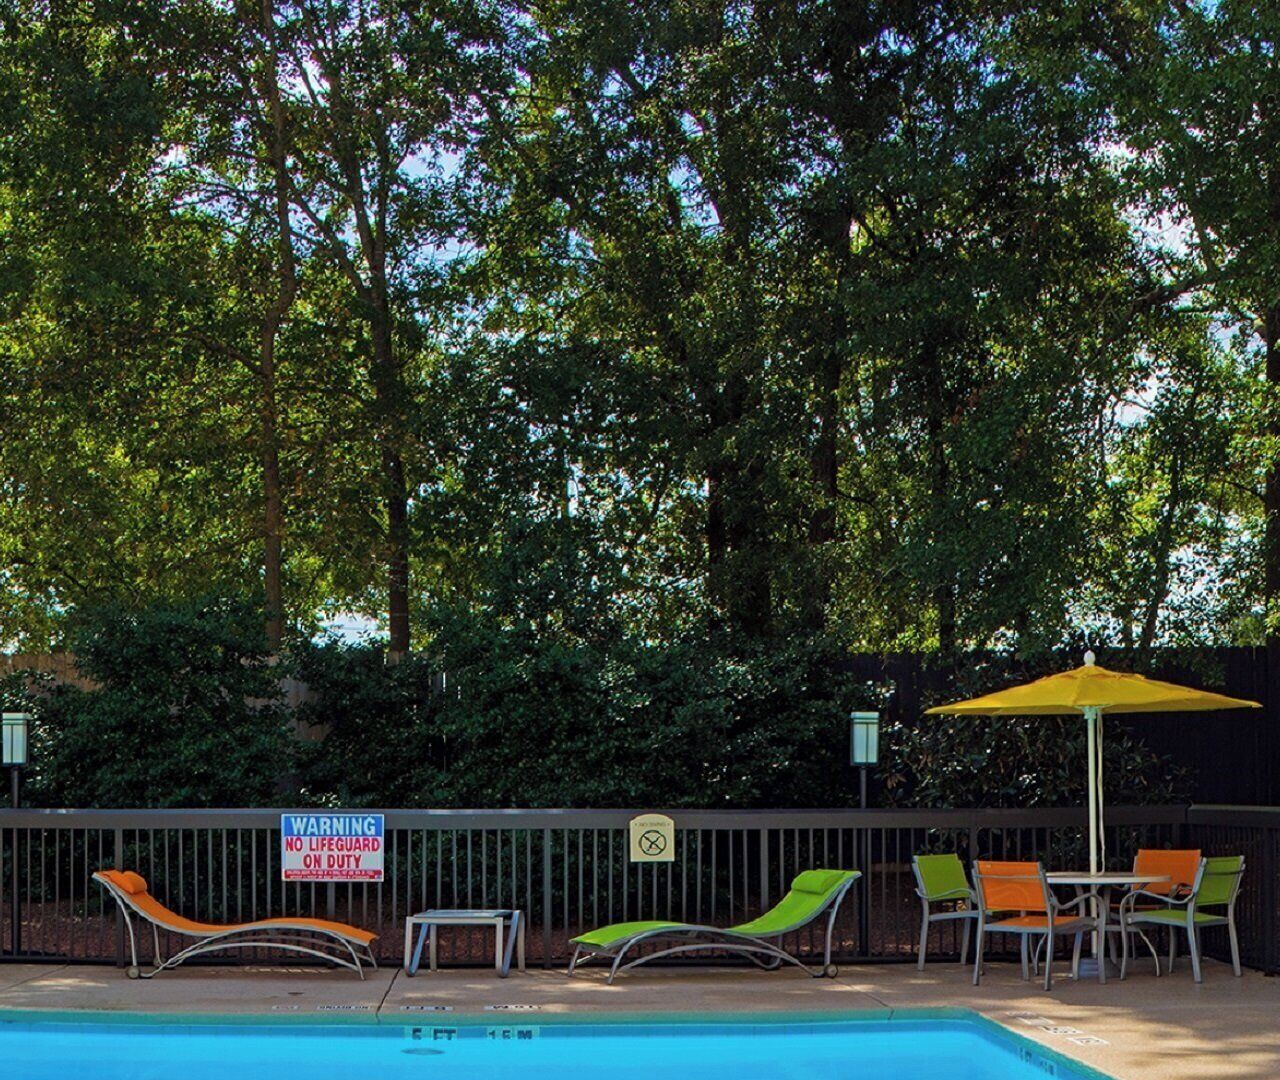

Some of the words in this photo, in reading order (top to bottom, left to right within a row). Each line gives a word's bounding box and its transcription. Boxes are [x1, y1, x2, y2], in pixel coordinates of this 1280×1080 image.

[291, 816, 376, 836] WARNING
[285, 836, 303, 852] NO
[309, 836, 380, 852] LIFEGUARD
[303, 853, 322, 868] ON
[327, 853, 362, 868] DUTY
[433, 1027, 456, 1041] FT
